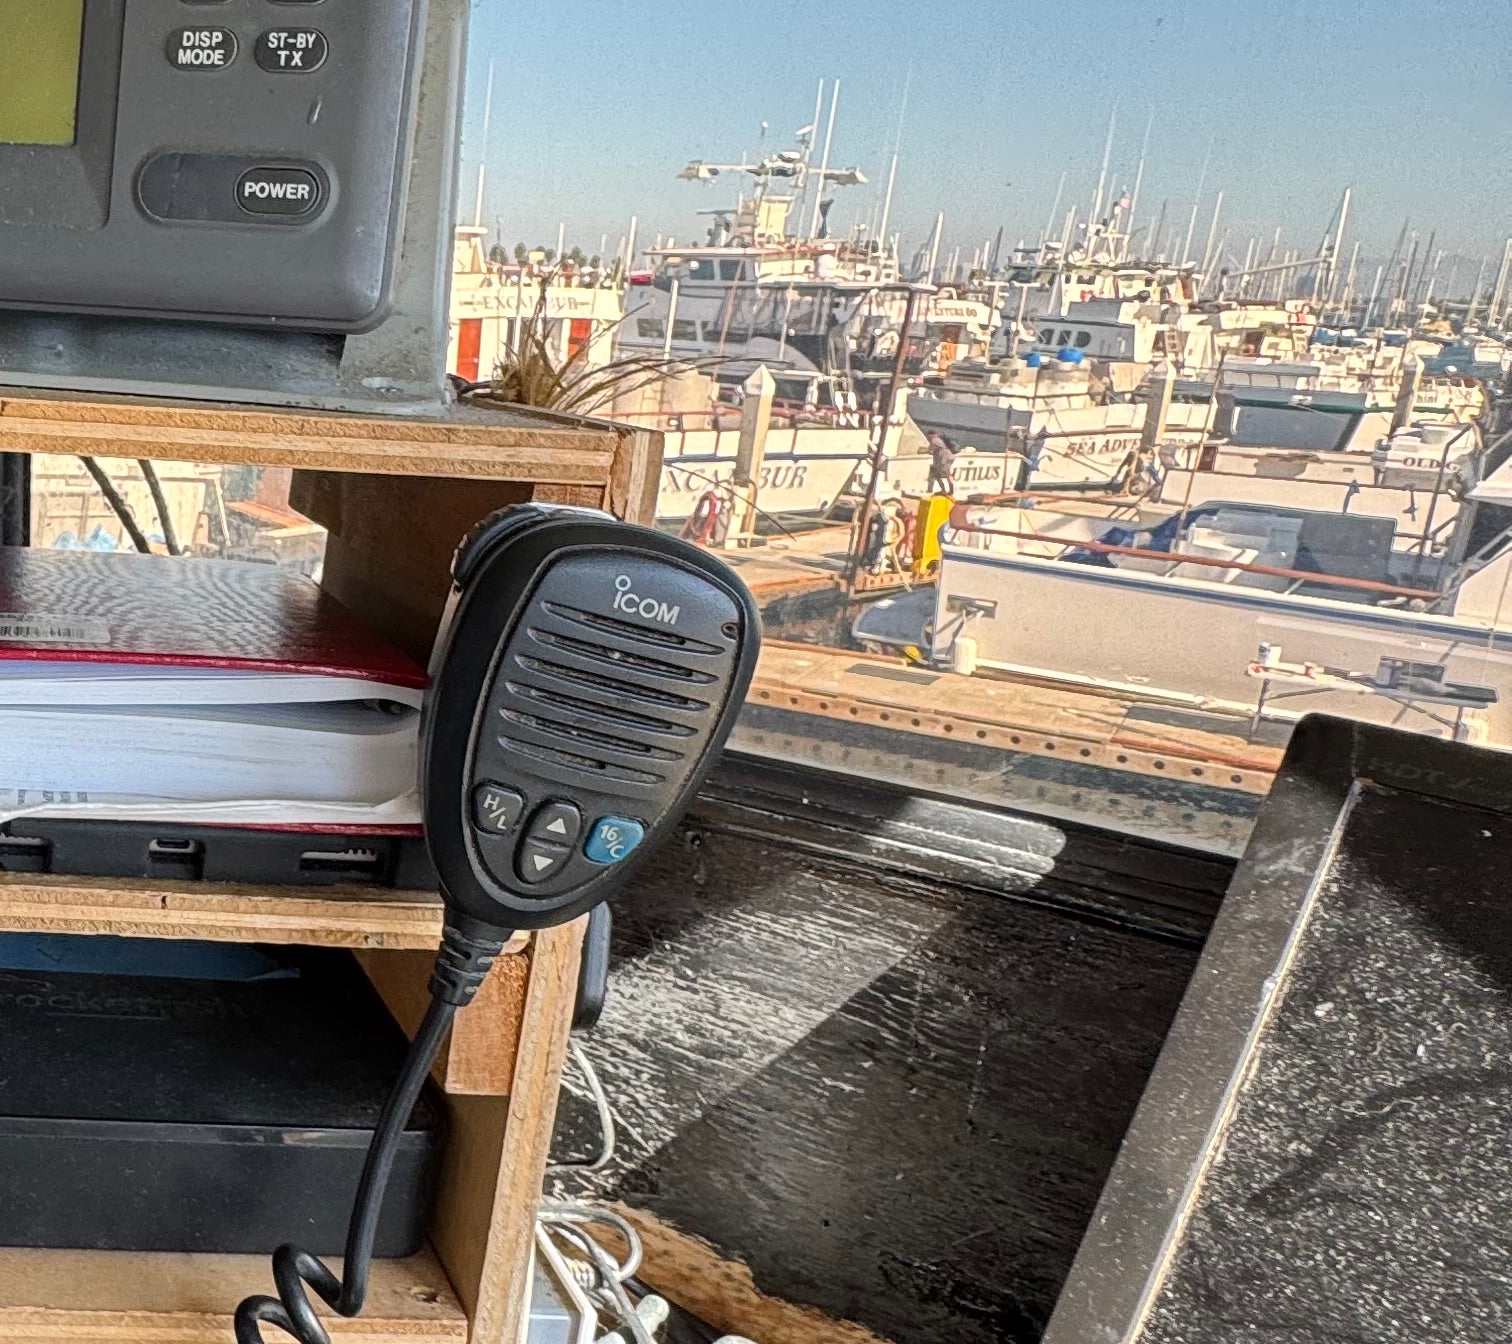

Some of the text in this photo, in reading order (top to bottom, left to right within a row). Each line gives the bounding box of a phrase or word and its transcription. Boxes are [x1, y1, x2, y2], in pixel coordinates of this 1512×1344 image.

[182, 31, 223, 47] DISP
[267, 32, 317, 50] ST-BY
[177, 49, 225, 66] MODE
[243, 181, 310, 200] POWER
[483, 295, 578, 310] EXCABUR
[1064, 441, 1096, 456] SEA
